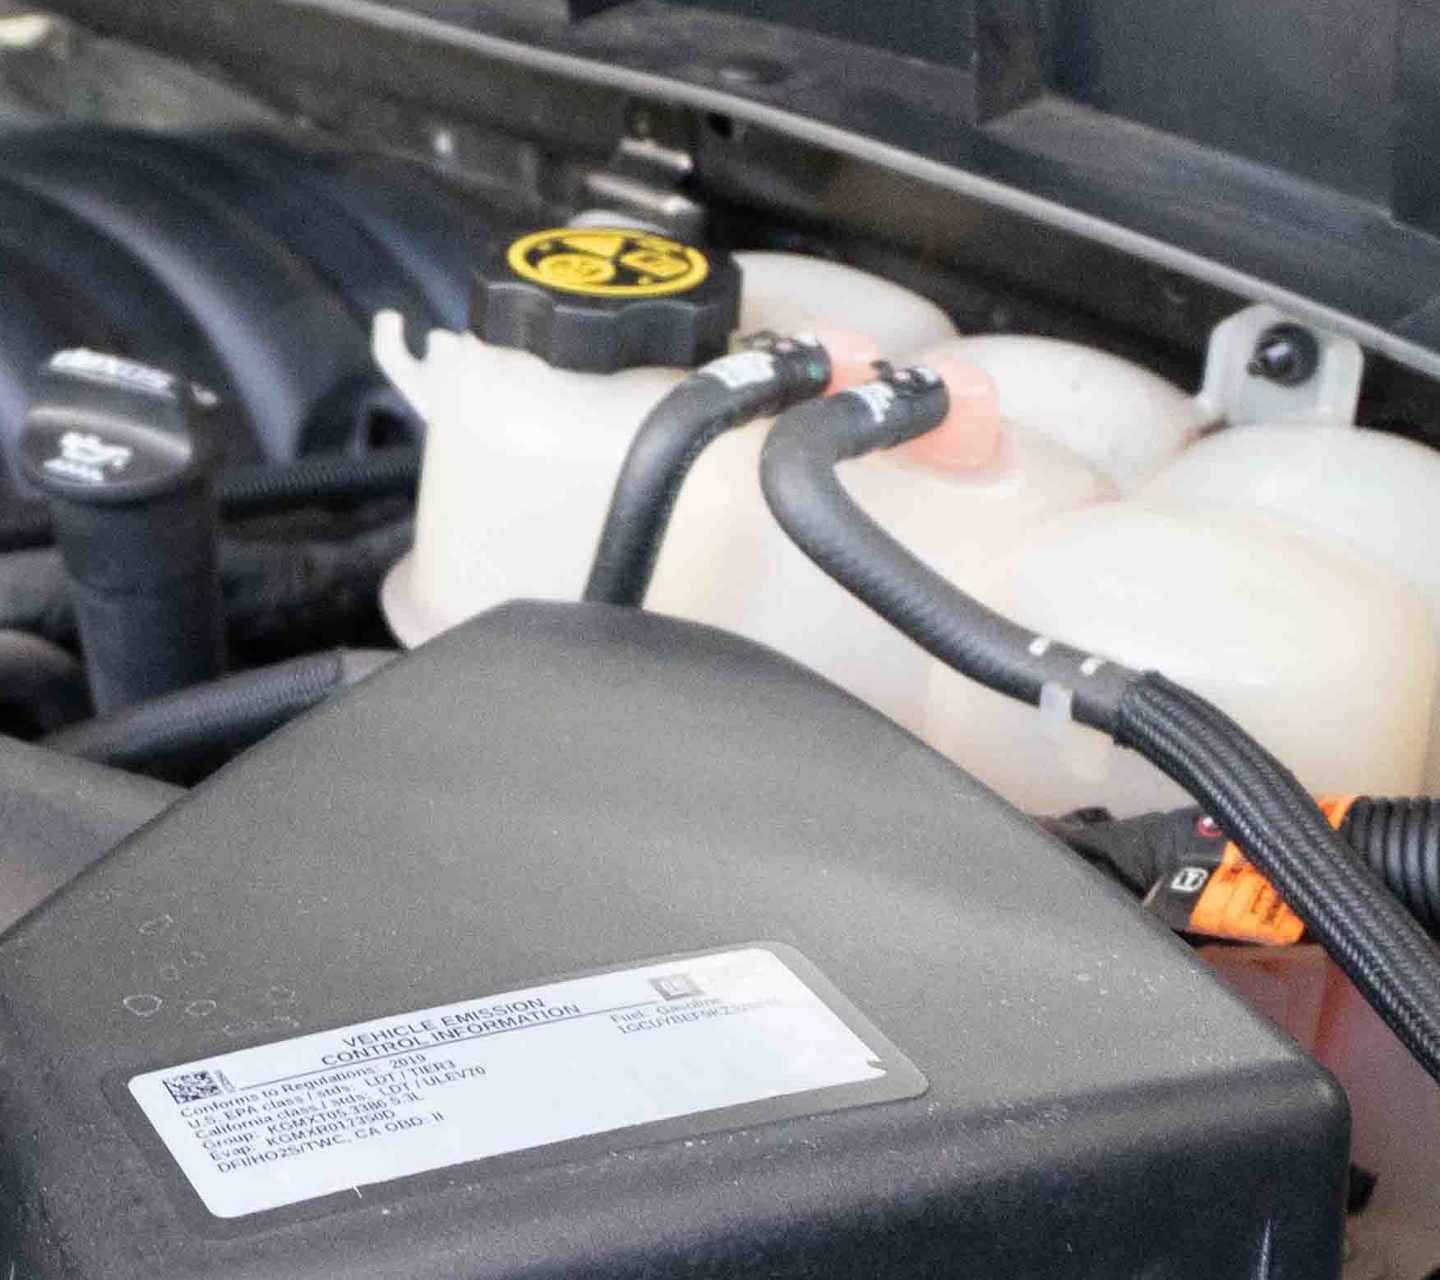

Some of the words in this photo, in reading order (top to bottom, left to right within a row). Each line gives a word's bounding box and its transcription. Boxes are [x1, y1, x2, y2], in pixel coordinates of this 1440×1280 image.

[322, 1036, 430, 1065] CONTROL
[432, 1004, 580, 1041] INFORMATION
[342, 1021, 437, 1047] VEHICLE
[441, 998, 545, 1026] EMISSION
[181, 1094, 258, 1117] Conforms
[262, 1088, 279, 1098] to
[187, 1116, 222, 1129] U.S.
[223, 1105, 257, 1120] EPA
[262, 1096, 303, 1110] class
[364, 1071, 395, 1087] LDT
[407, 1060, 456, 1076] TIER3
[196, 1116, 272, 1139] California
[277, 1105, 319, 1119] class
[379, 1082, 410, 1095] LDT
[423, 1066, 486, 1086] ULEV70
[355, 1127, 382, 1139] CA
